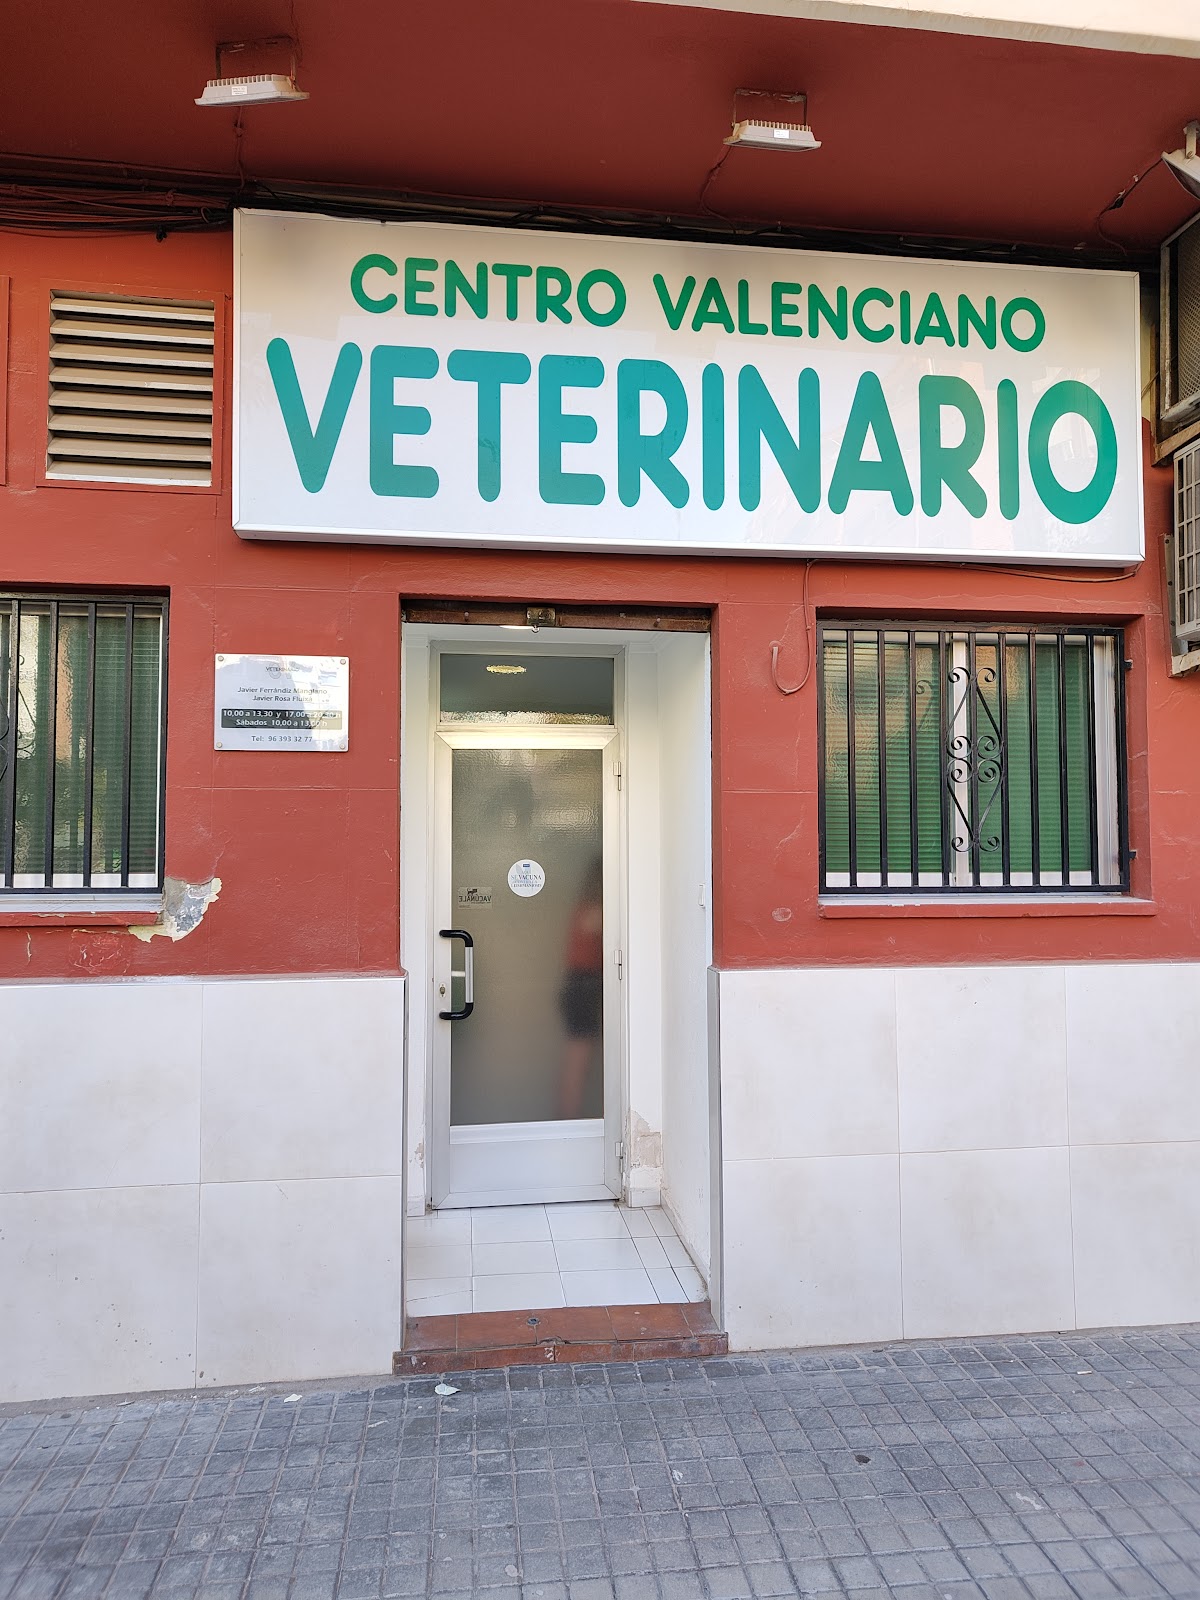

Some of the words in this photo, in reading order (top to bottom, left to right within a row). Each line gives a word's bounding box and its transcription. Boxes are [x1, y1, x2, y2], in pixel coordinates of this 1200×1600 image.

[350, 253, 628, 328] CENTRO
[652, 273, 1046, 353] VALENCIANO
[265, 337, 1118, 525] VETERINARIO
[259, 686, 292, 694] Ferrándiz
[235, 718, 268, 726] Sábados
